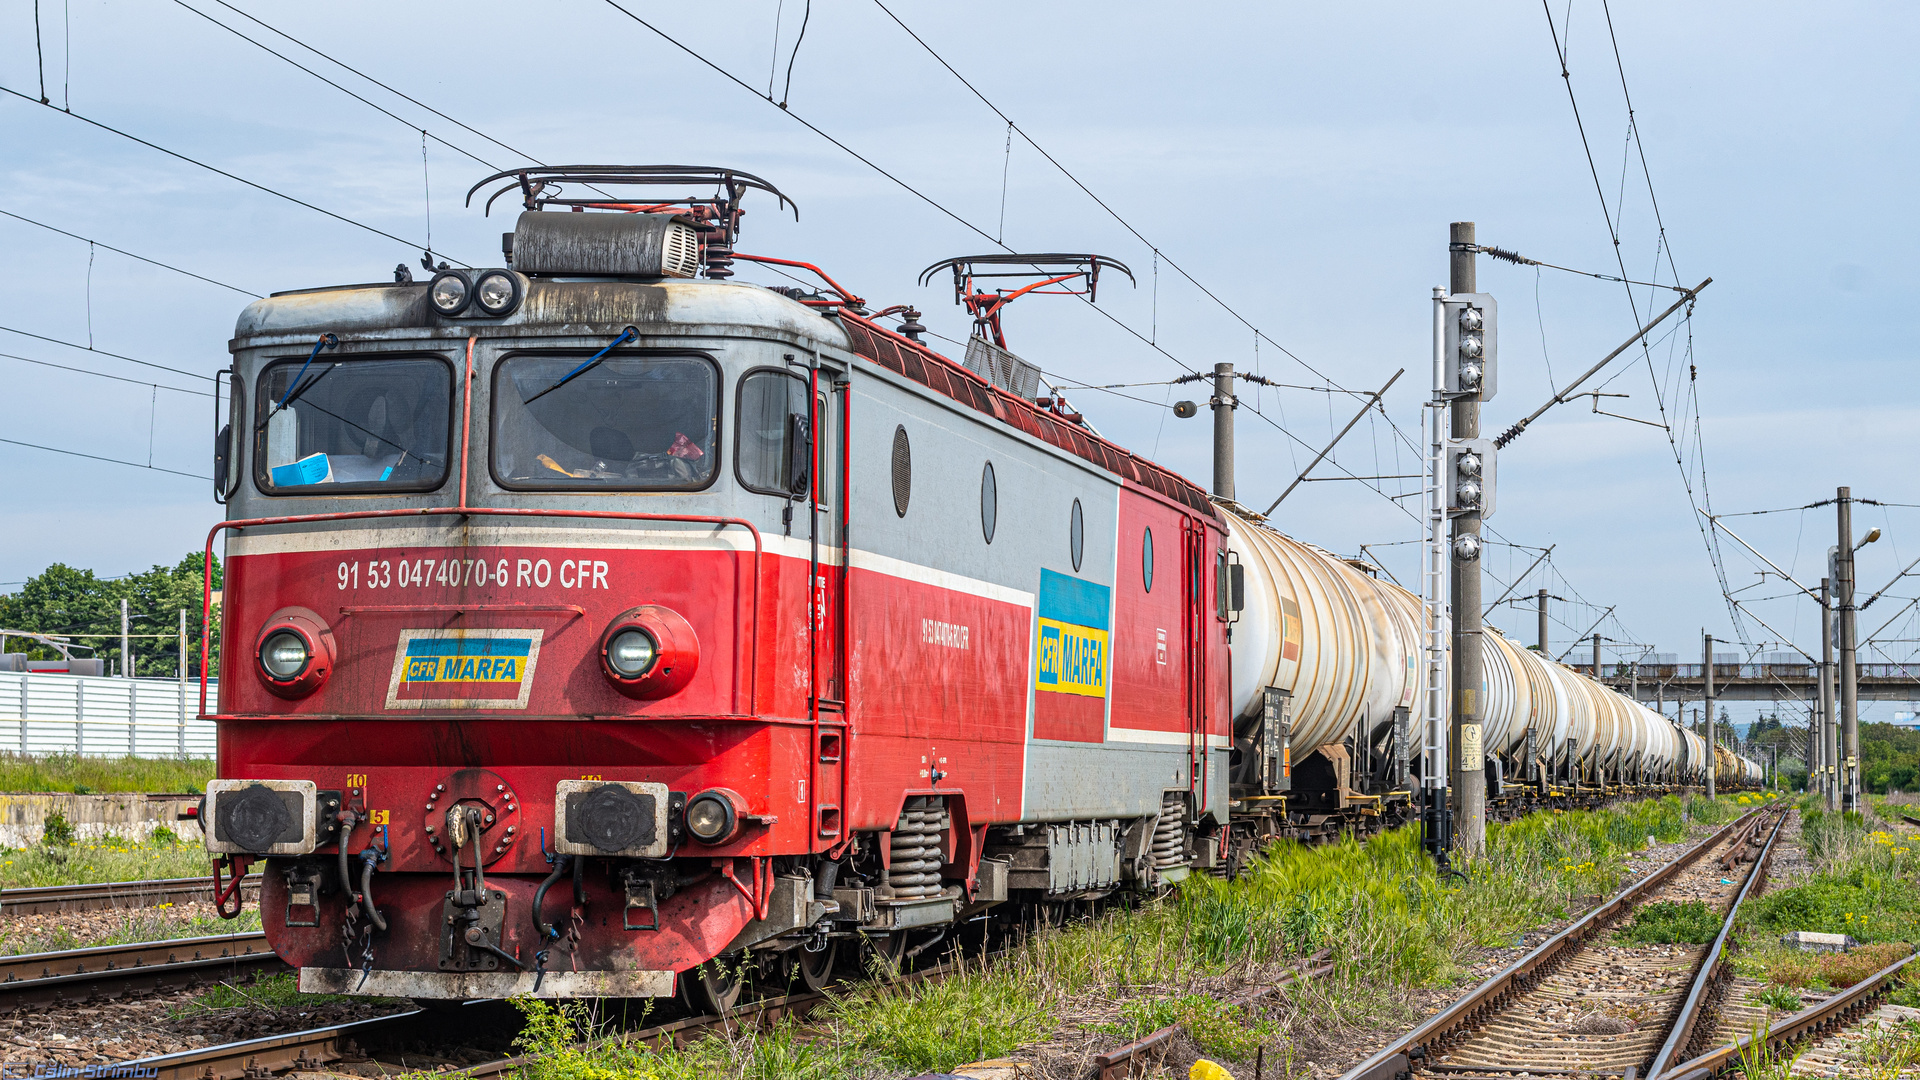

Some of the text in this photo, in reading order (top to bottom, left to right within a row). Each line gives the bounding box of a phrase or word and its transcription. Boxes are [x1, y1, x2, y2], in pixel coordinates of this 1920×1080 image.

[337, 558, 609, 590] 91 53 0474070-6 RO CFR
[409, 658, 516, 680] CFR MARFA
[1041, 635, 1058, 674] CFR
[1062, 633, 1102, 687] MARFA
[348, 774, 365, 788] 10
[374, 810, 384, 824] 5
